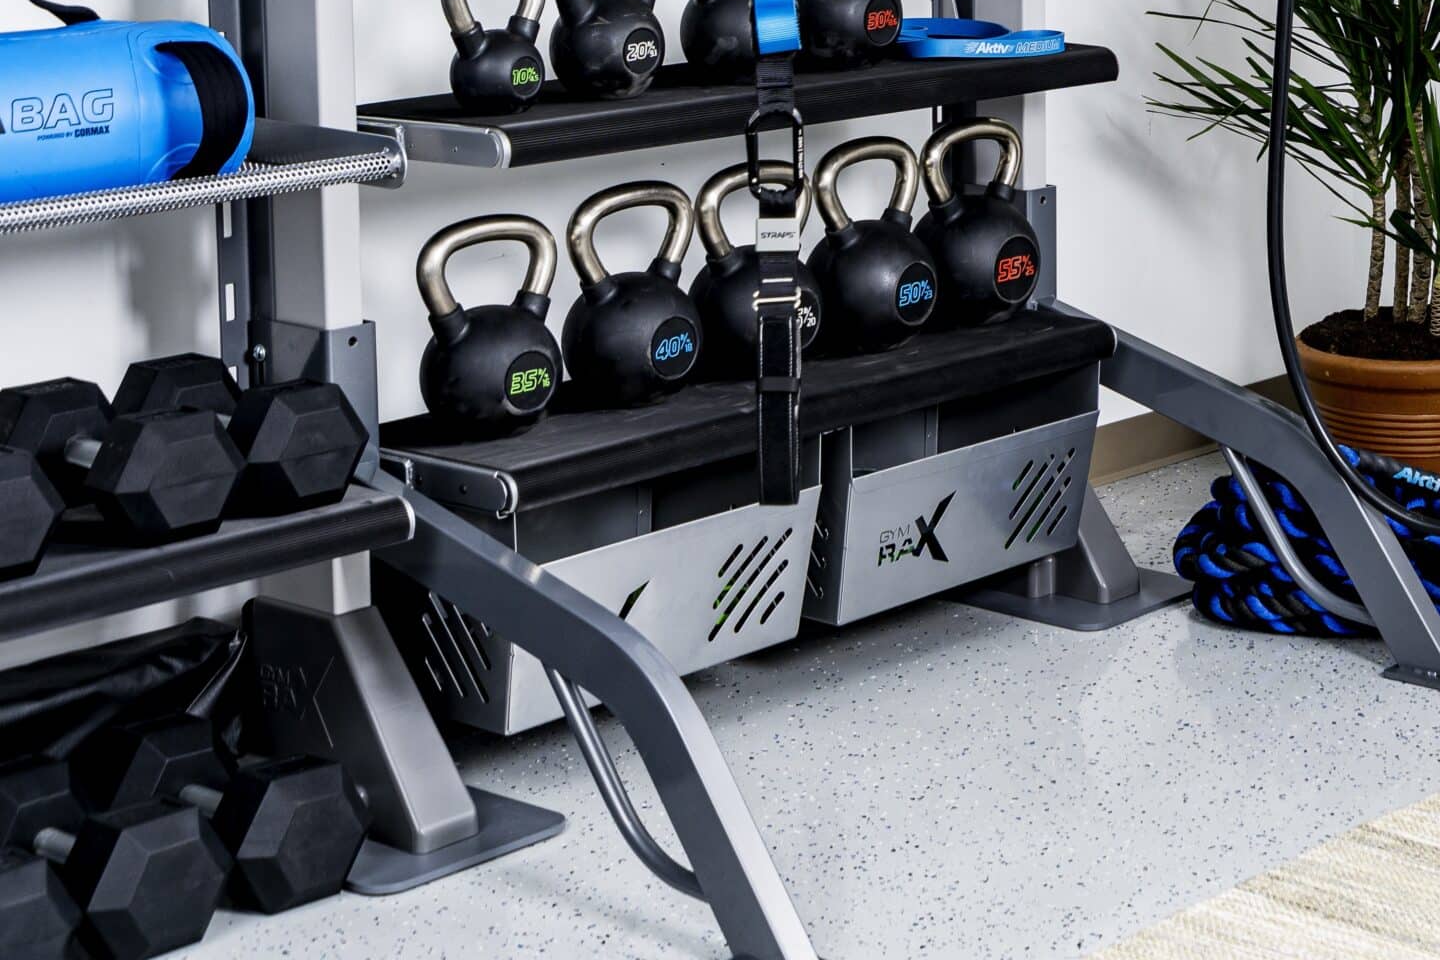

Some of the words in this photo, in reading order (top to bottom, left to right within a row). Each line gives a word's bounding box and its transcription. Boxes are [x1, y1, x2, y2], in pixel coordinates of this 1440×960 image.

[976, 41, 1008, 54] Aktiv
[11, 88, 114, 133] BAG
[75, 125, 110, 138] CORMAX
[879, 524, 911, 544] GYM
